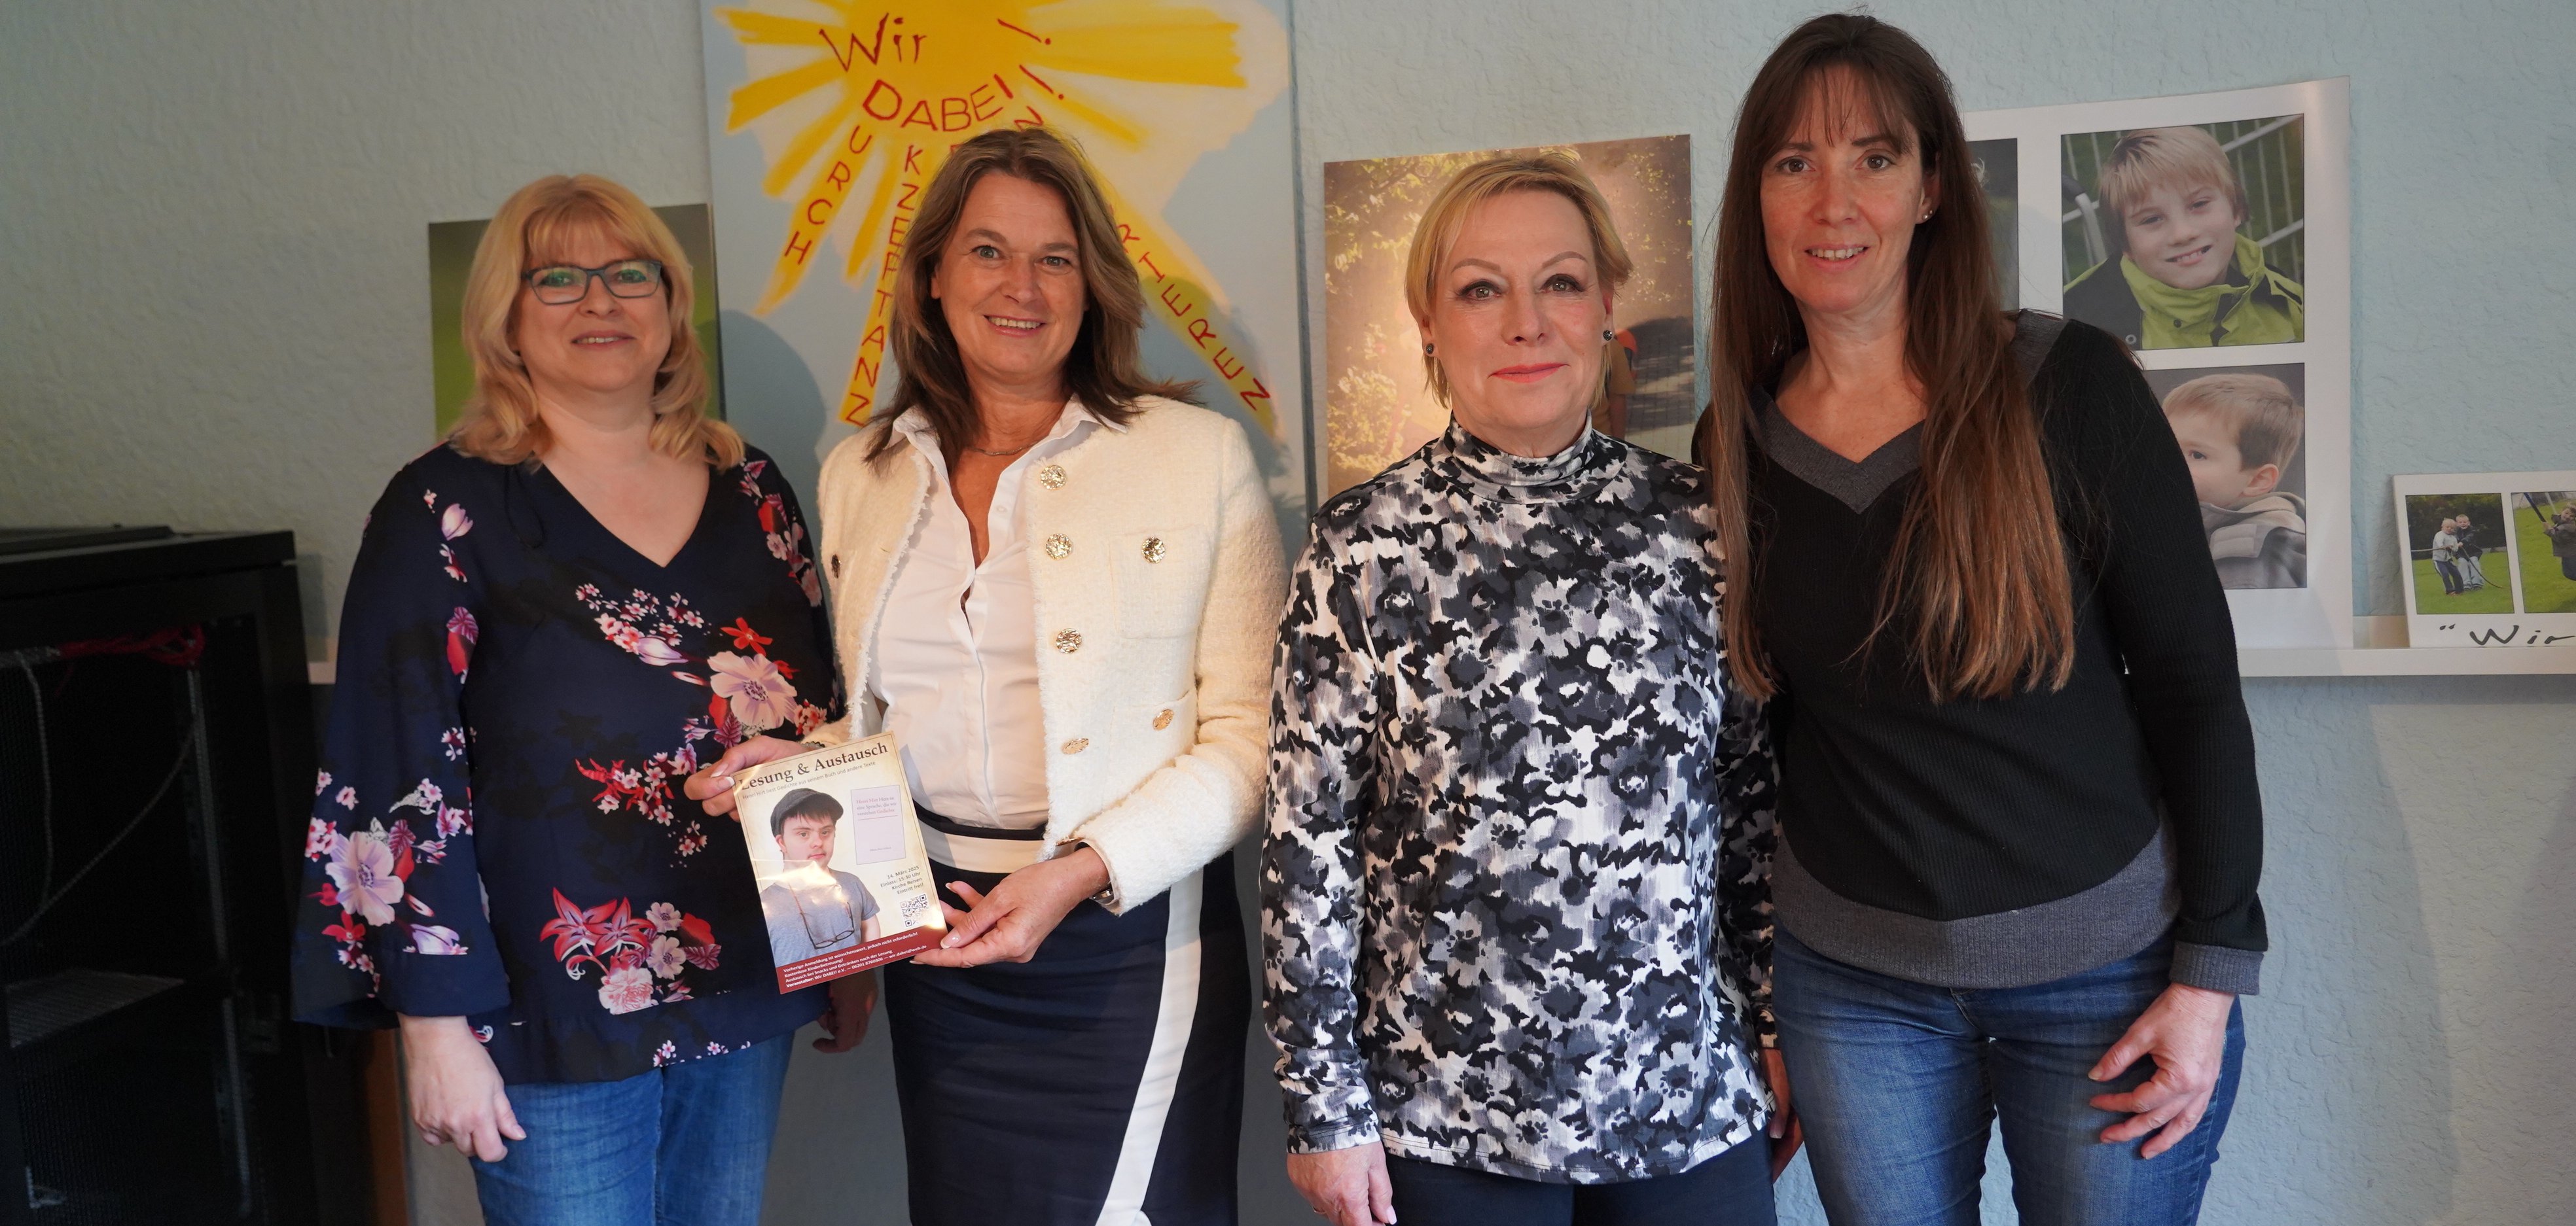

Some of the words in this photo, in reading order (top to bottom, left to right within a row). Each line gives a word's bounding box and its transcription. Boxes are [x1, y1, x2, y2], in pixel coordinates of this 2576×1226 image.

[819, 12, 927, 72] Wir
[797, 763, 810, 775] &
[815, 743, 887, 770] Austausch
[804, 958, 828, 966] Anmeldung
[893, 932, 918, 942] erforderlich!
[785, 969, 807, 977] Kostenlose
[808, 958, 843, 971] Kinderbetreuung!
[785, 974, 807, 983] Austausch
[786, 977, 814, 987] Veranstalter:
